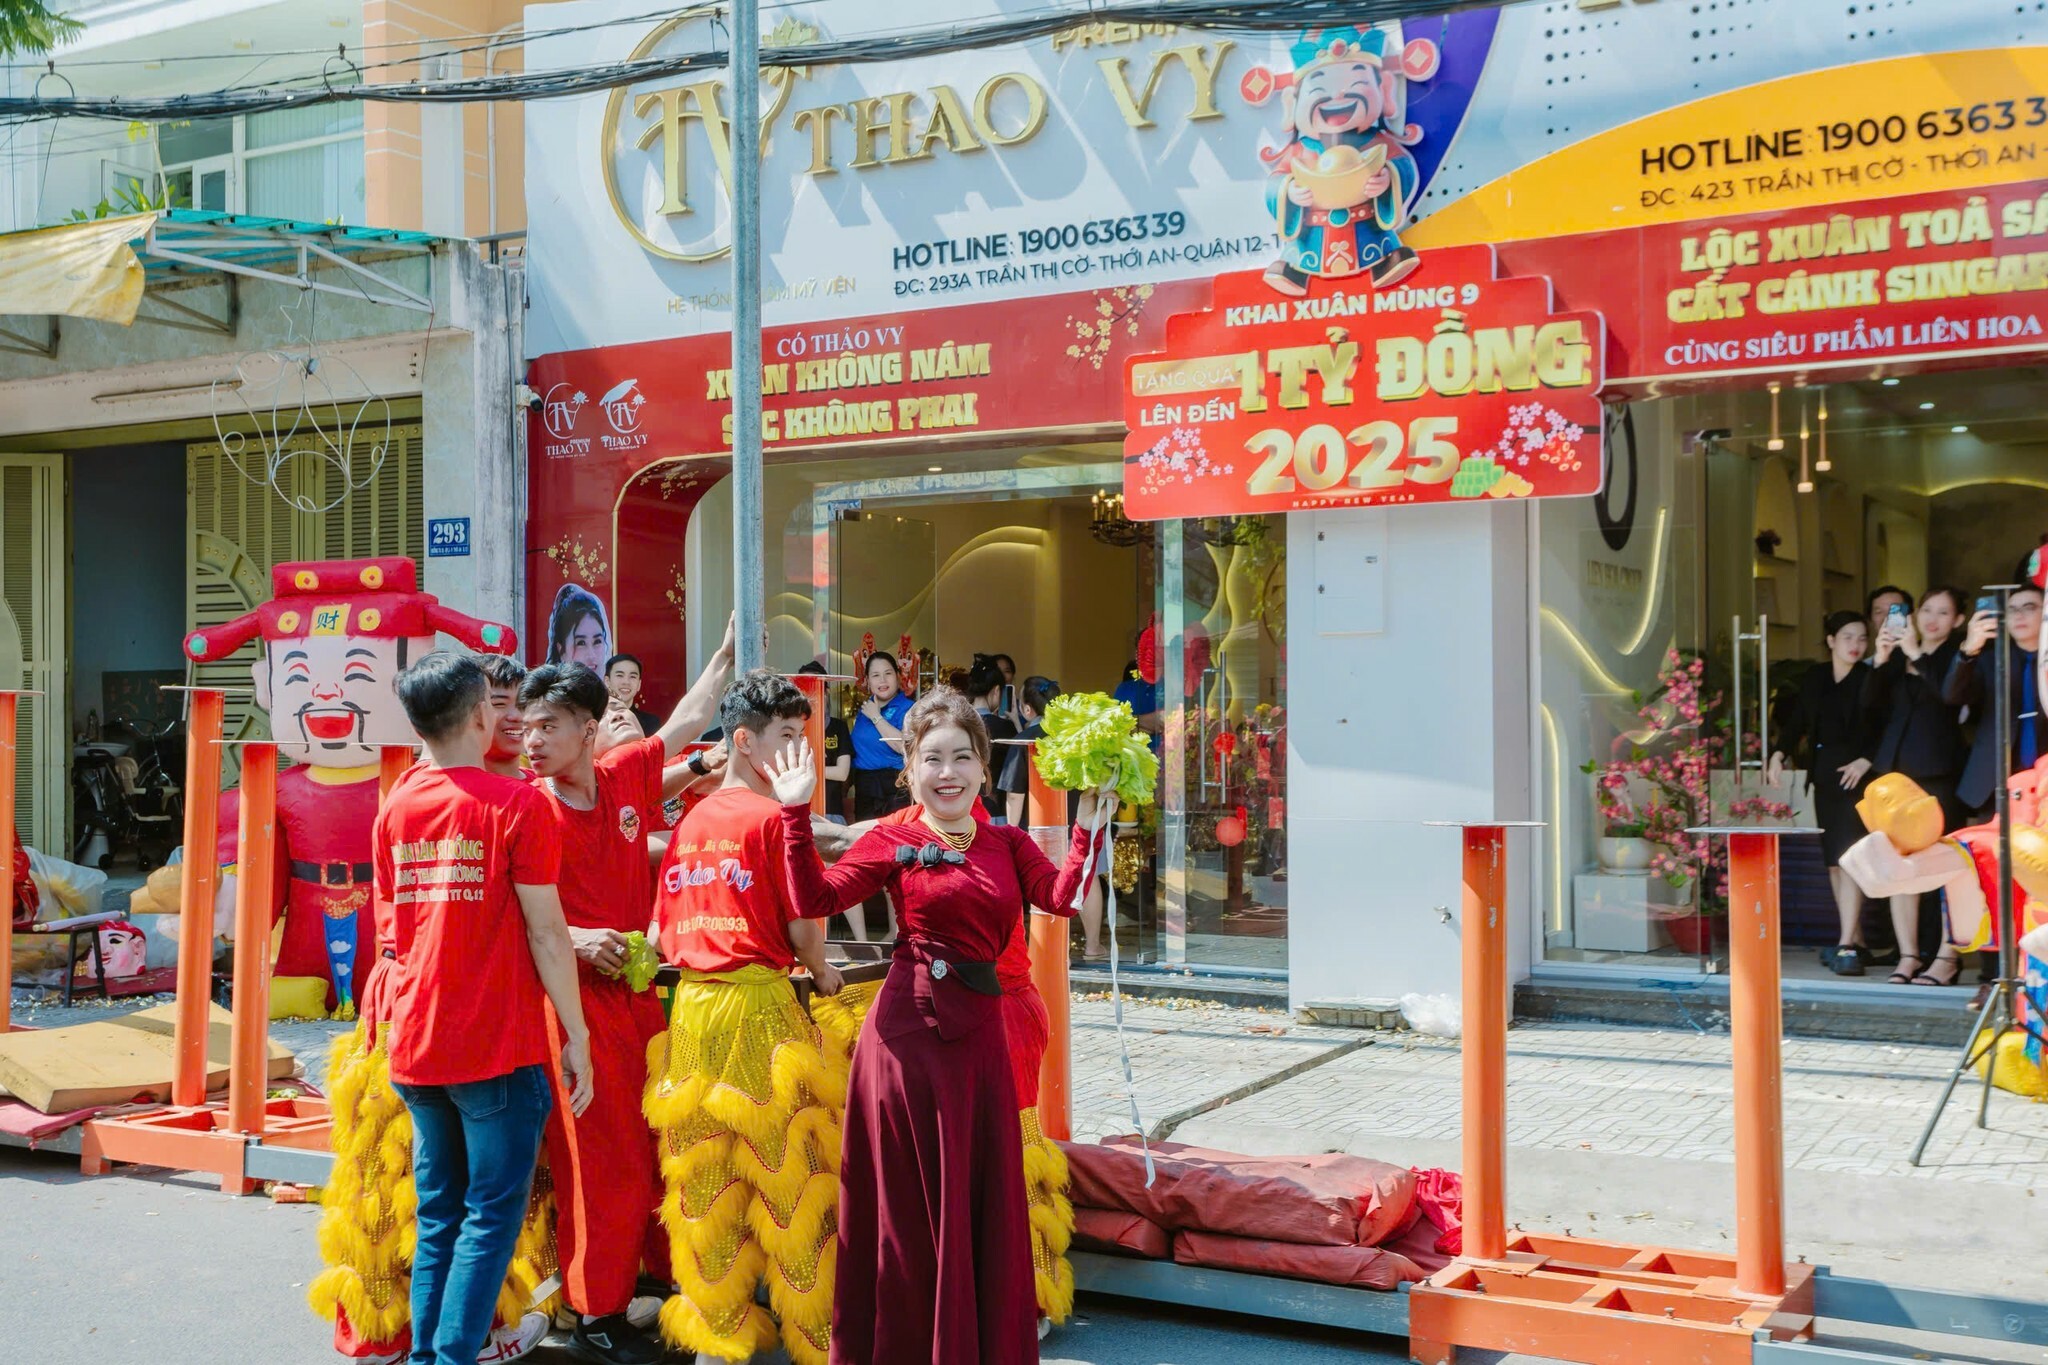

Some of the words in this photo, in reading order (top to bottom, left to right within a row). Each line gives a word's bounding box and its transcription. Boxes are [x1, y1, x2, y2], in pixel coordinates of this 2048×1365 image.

[791, 73, 1047, 176] THAO
[1096, 40, 1237, 128] VY
[1817, 116, 1906, 152] 1900
[1917, 101, 2016, 140] 6363
[1690, 180, 1734, 200] 423
[1997, 142, 2036, 165] AN
[893, 233, 1015, 270] HOTLINE:
[1680, 227, 1760, 275] LỘC
[1767, 213, 1892, 264] XUÂN
[894, 278, 926, 295] ĐC:
[929, 272, 972, 292] 293A
[1030, 261, 1058, 280] THỊ
[1666, 273, 1751, 324] CẤT
[1225, 301, 1287, 327] KHAI
[1293, 291, 1368, 321] XUÂN
[1374, 284, 1456, 313] MÙNG
[1461, 283, 1480, 305] 9
[776, 332, 807, 358] CÓ
[811, 326, 870, 354] THẢO
[874, 325, 905, 347] VY
[1235, 349, 1268, 413] 1
[1375, 308, 1592, 402] ĐỒNG
[1664, 338, 1740, 366] CÙNG
[1745, 330, 1807, 360] SIÊU
[1902, 316, 1970, 346] LIÊN
[1977, 314, 2043, 340] HOA
[706, 363, 790, 401] XN
[795, 350, 903, 393] KHÔNG
[910, 339, 993, 382] NÁM
[784, 397, 893, 440] KHÔNG
[898, 392, 979, 431] PHAI
[1140, 402, 1182, 427] LÊN
[1186, 396, 1235, 424] ĐẾN
[1244, 416, 1461, 496] 2025
[432, 522, 466, 545] 293
